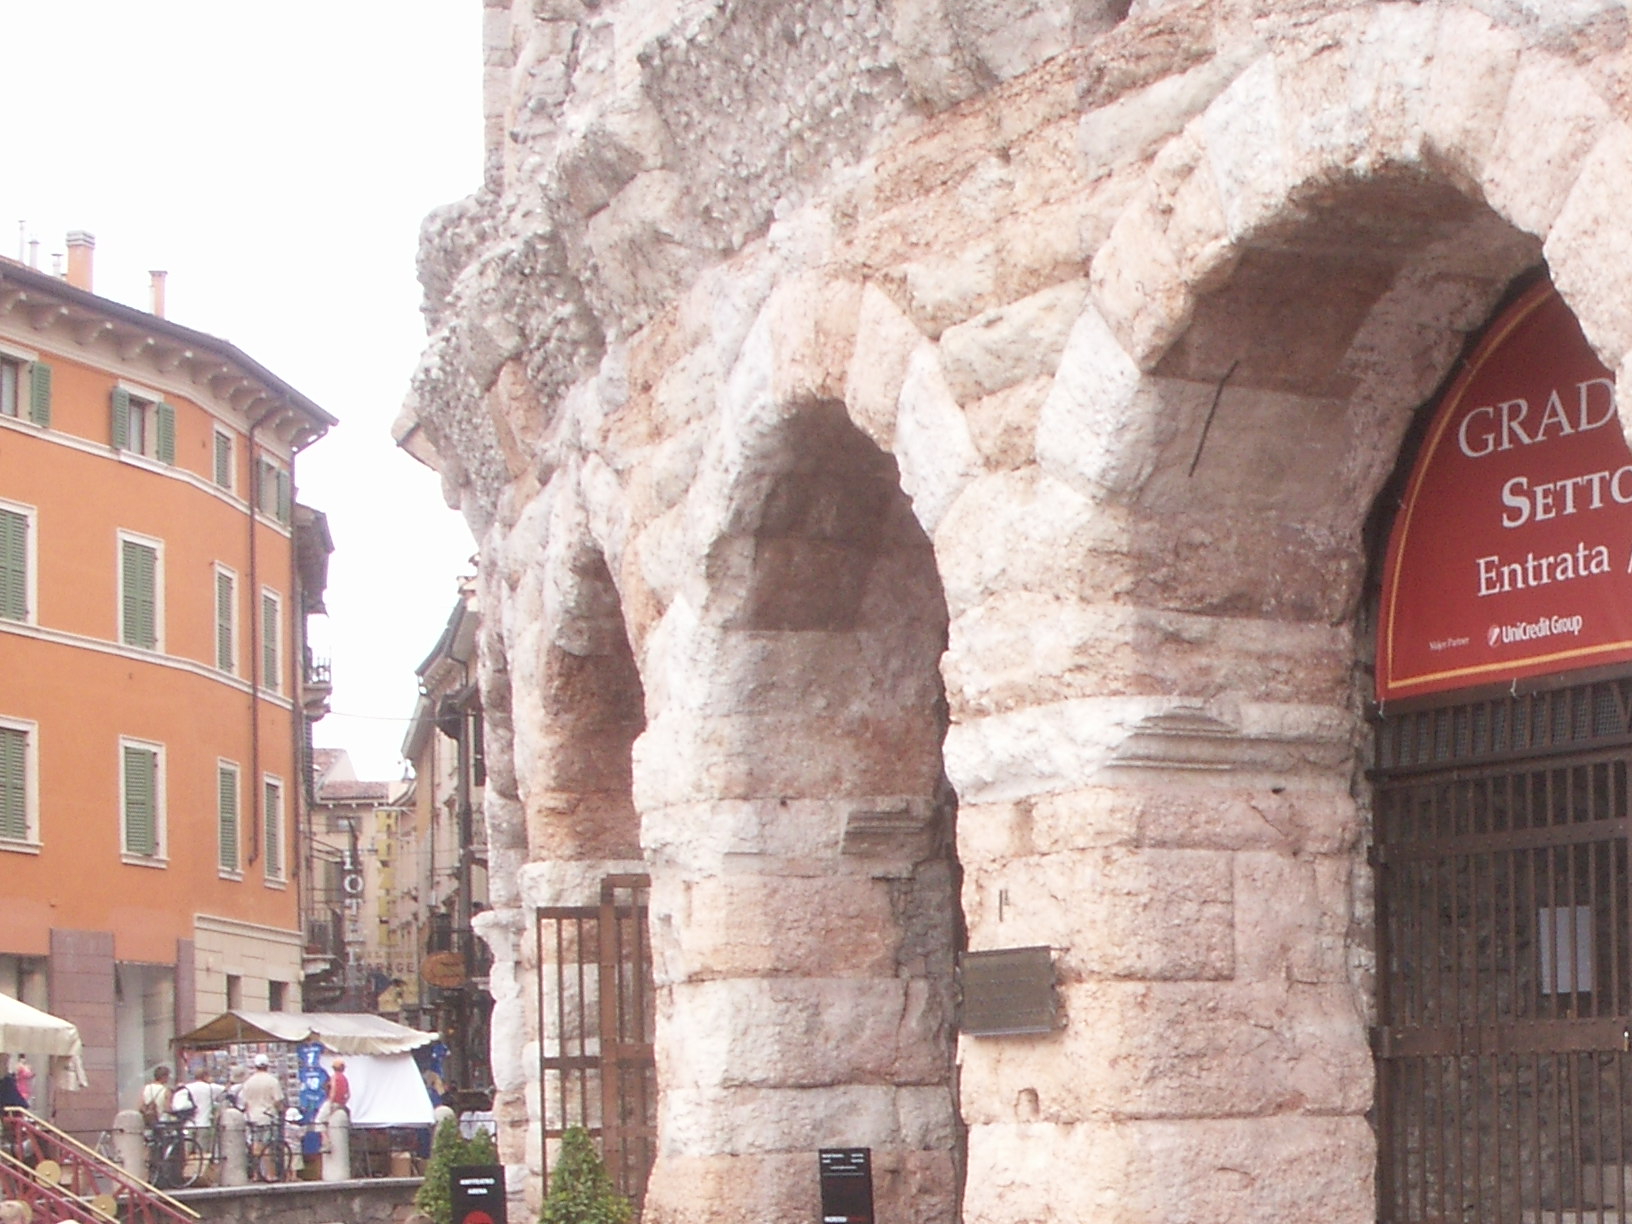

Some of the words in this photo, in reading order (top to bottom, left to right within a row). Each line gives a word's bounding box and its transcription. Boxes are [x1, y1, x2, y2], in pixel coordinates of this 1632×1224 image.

[1458, 376, 1616, 458] GRAD
[1476, 541, 1611, 597] Entrata
[1502, 617, 1550, 643] UniCredit
[1551, 615, 1583, 636] Group
